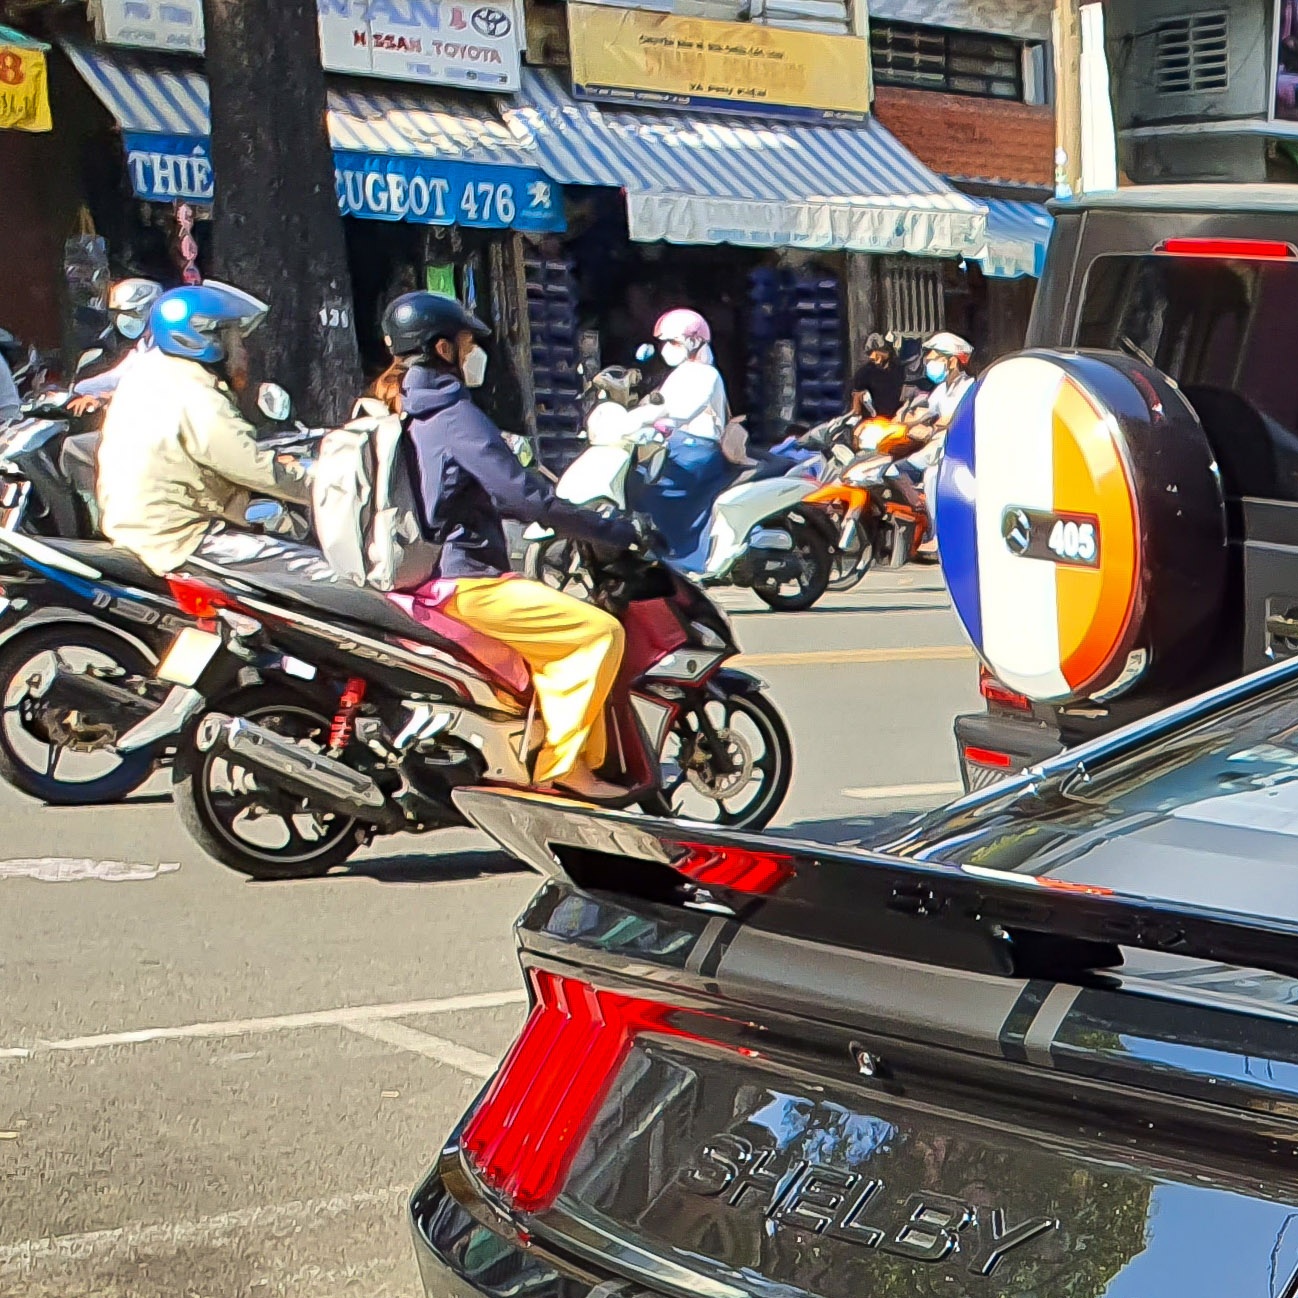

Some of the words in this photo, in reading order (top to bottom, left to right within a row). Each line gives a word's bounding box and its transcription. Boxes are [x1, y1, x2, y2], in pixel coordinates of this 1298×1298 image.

[431, 40, 502, 64] TOYOTA
[460, 181, 516, 224] 476
[1048, 519, 1095, 559] 405
[683, 1132, 1060, 1277] SHELBY
